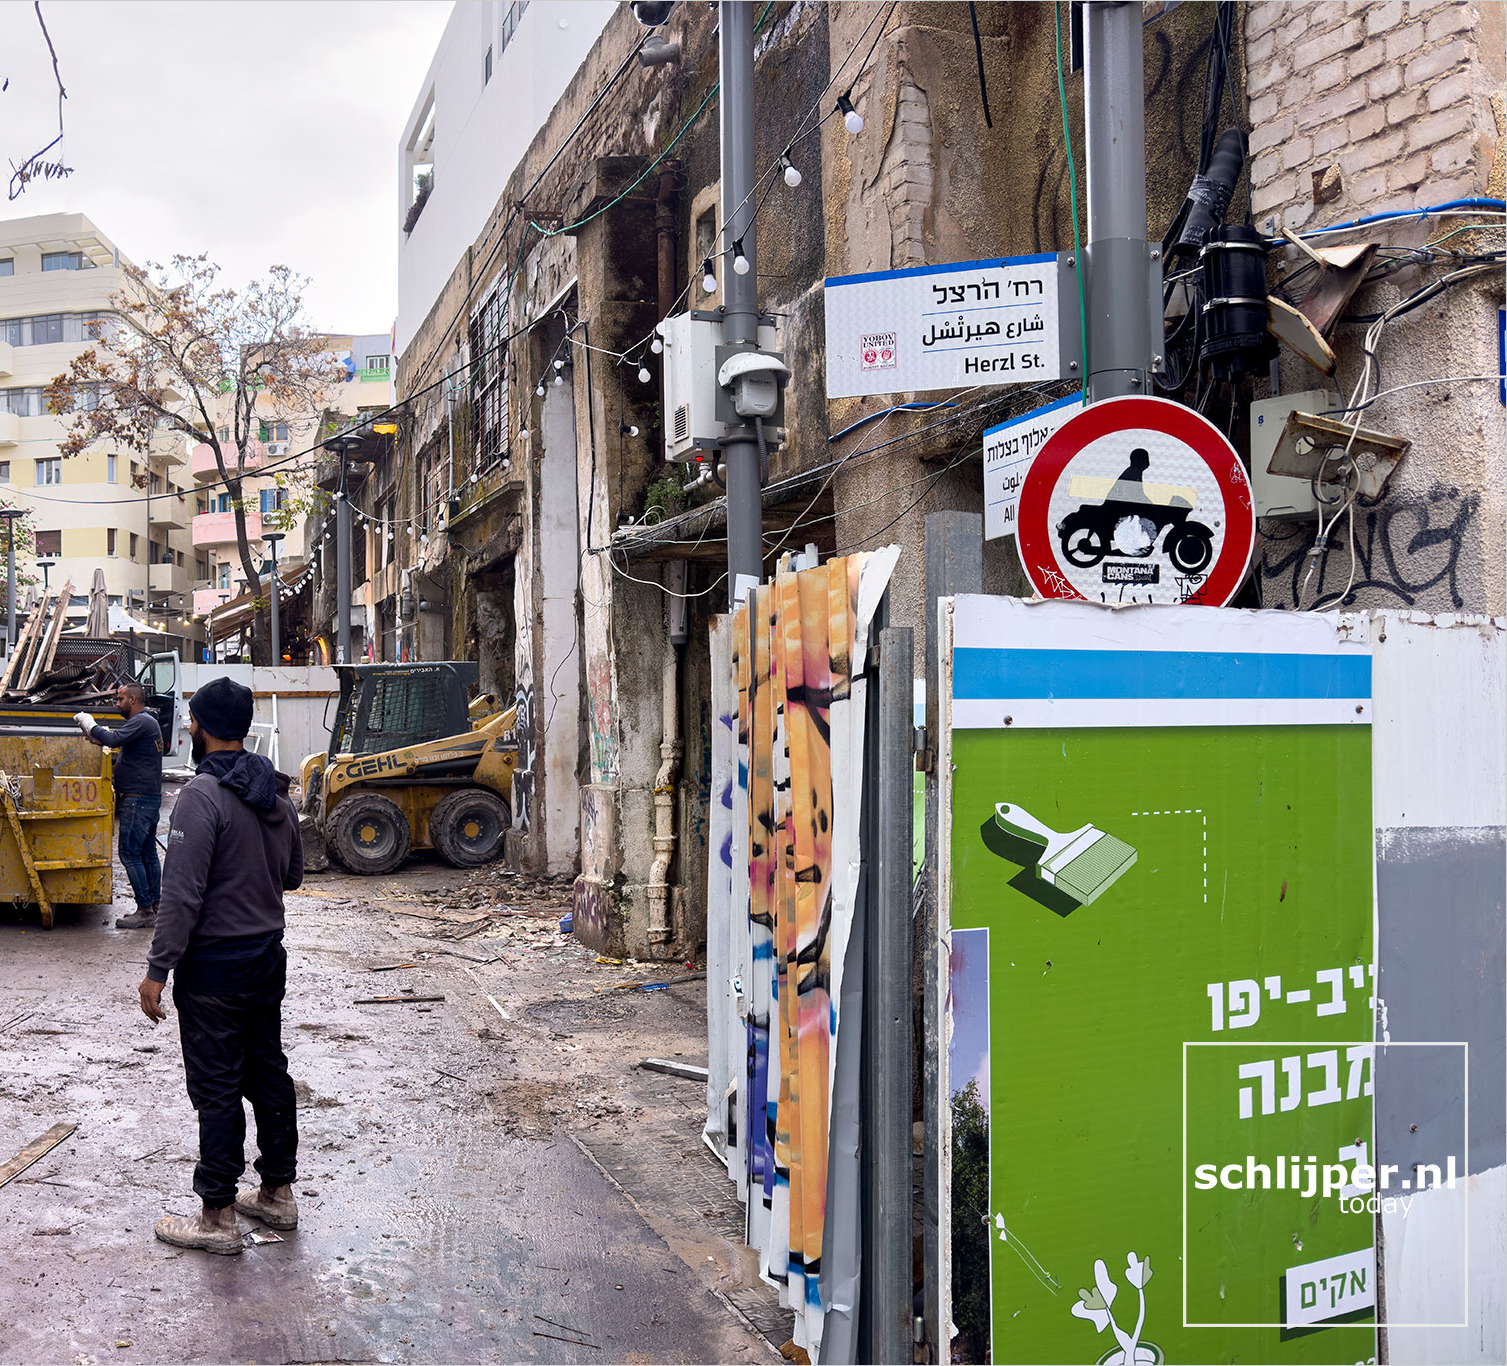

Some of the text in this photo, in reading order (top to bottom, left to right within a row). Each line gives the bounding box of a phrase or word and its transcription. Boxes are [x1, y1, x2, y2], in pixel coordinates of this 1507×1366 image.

[965, 352, 1045, 374] Herzl St.
[1022, 427, 1048, 455] אלוף
[1107, 566, 1154, 575] MONTANA
[345, 754, 407, 779] GEHL
[61, 780, 98, 802] 130
[1207, 964, 1374, 1031] יב-יפו
[1239, 1045, 1374, 1119] מבנה
[1301, 1267, 1367, 1309] אקים
